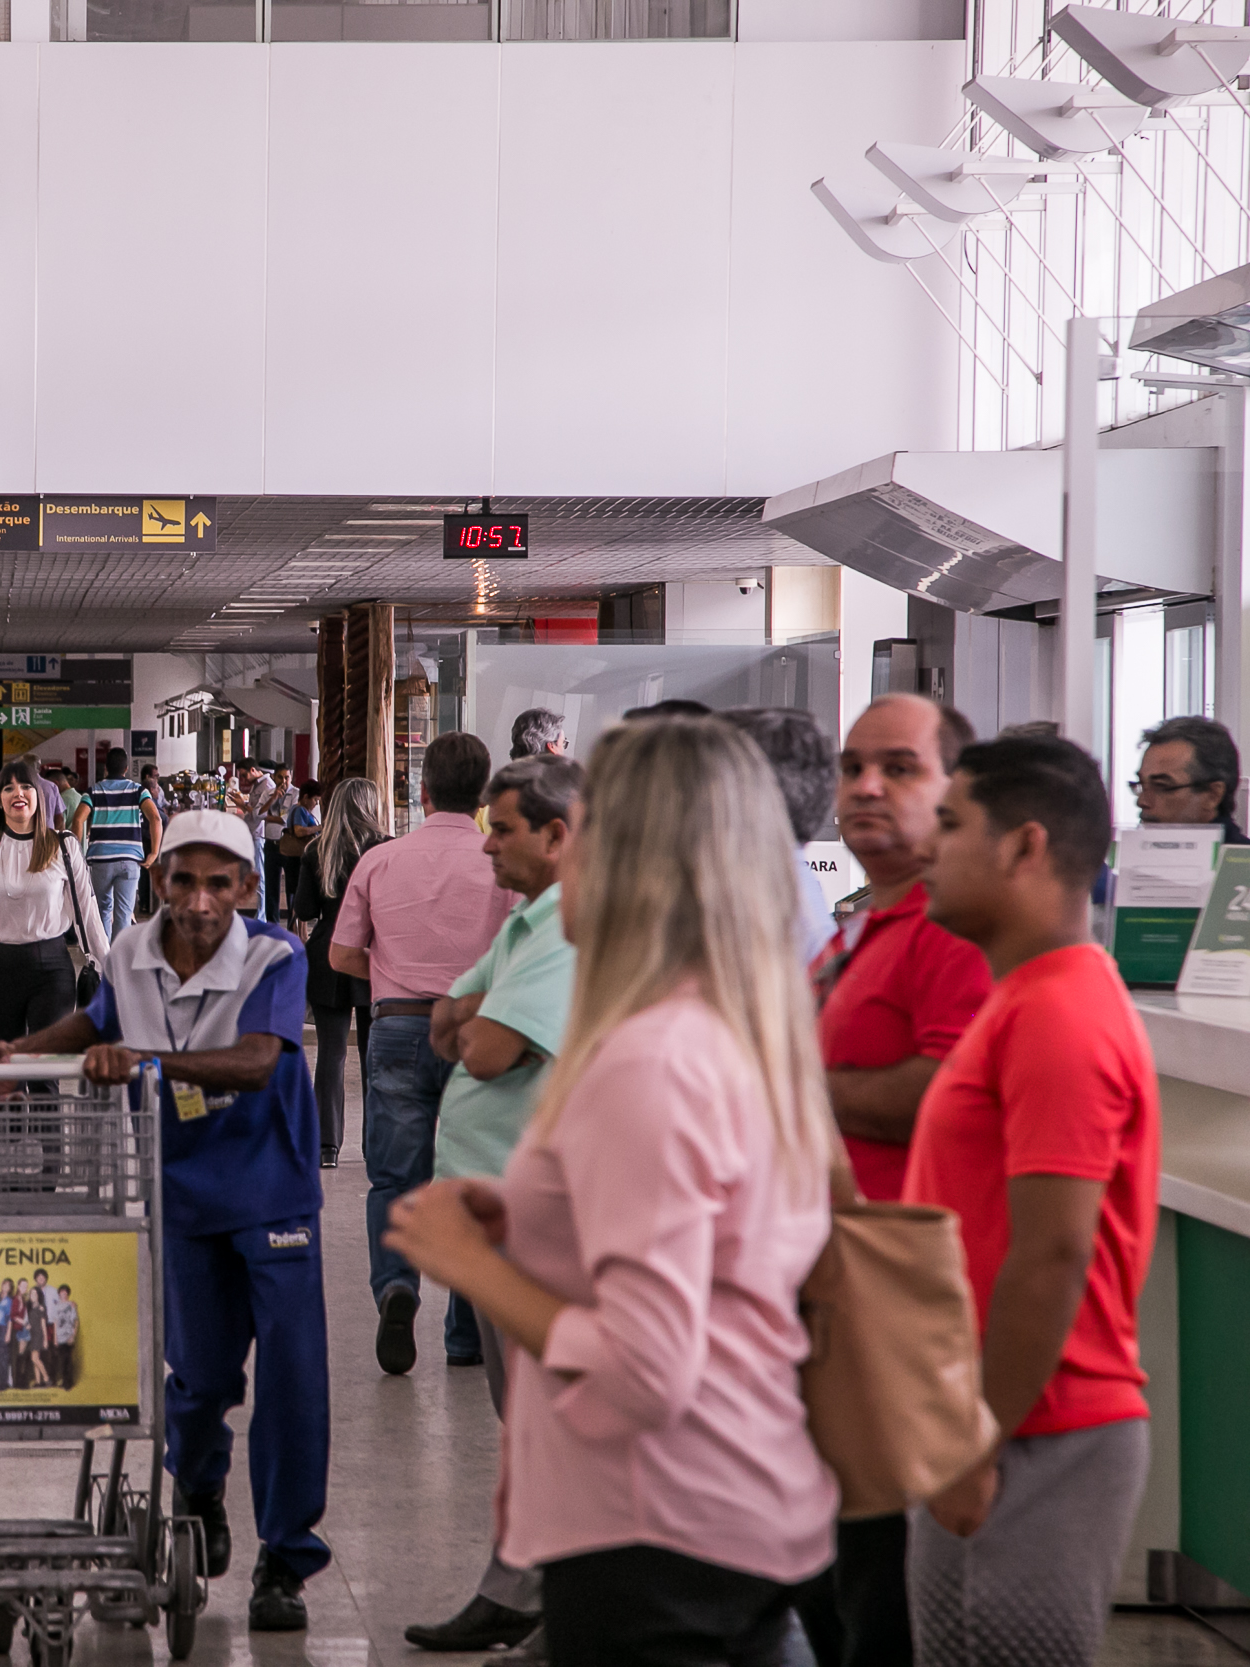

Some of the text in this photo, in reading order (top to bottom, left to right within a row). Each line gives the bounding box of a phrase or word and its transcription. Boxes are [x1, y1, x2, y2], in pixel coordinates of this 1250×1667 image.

[46, 503, 140, 517] Desembarque
[56, 534, 140, 543] International Arrivals
[459, 525, 522, 548] 10:57
